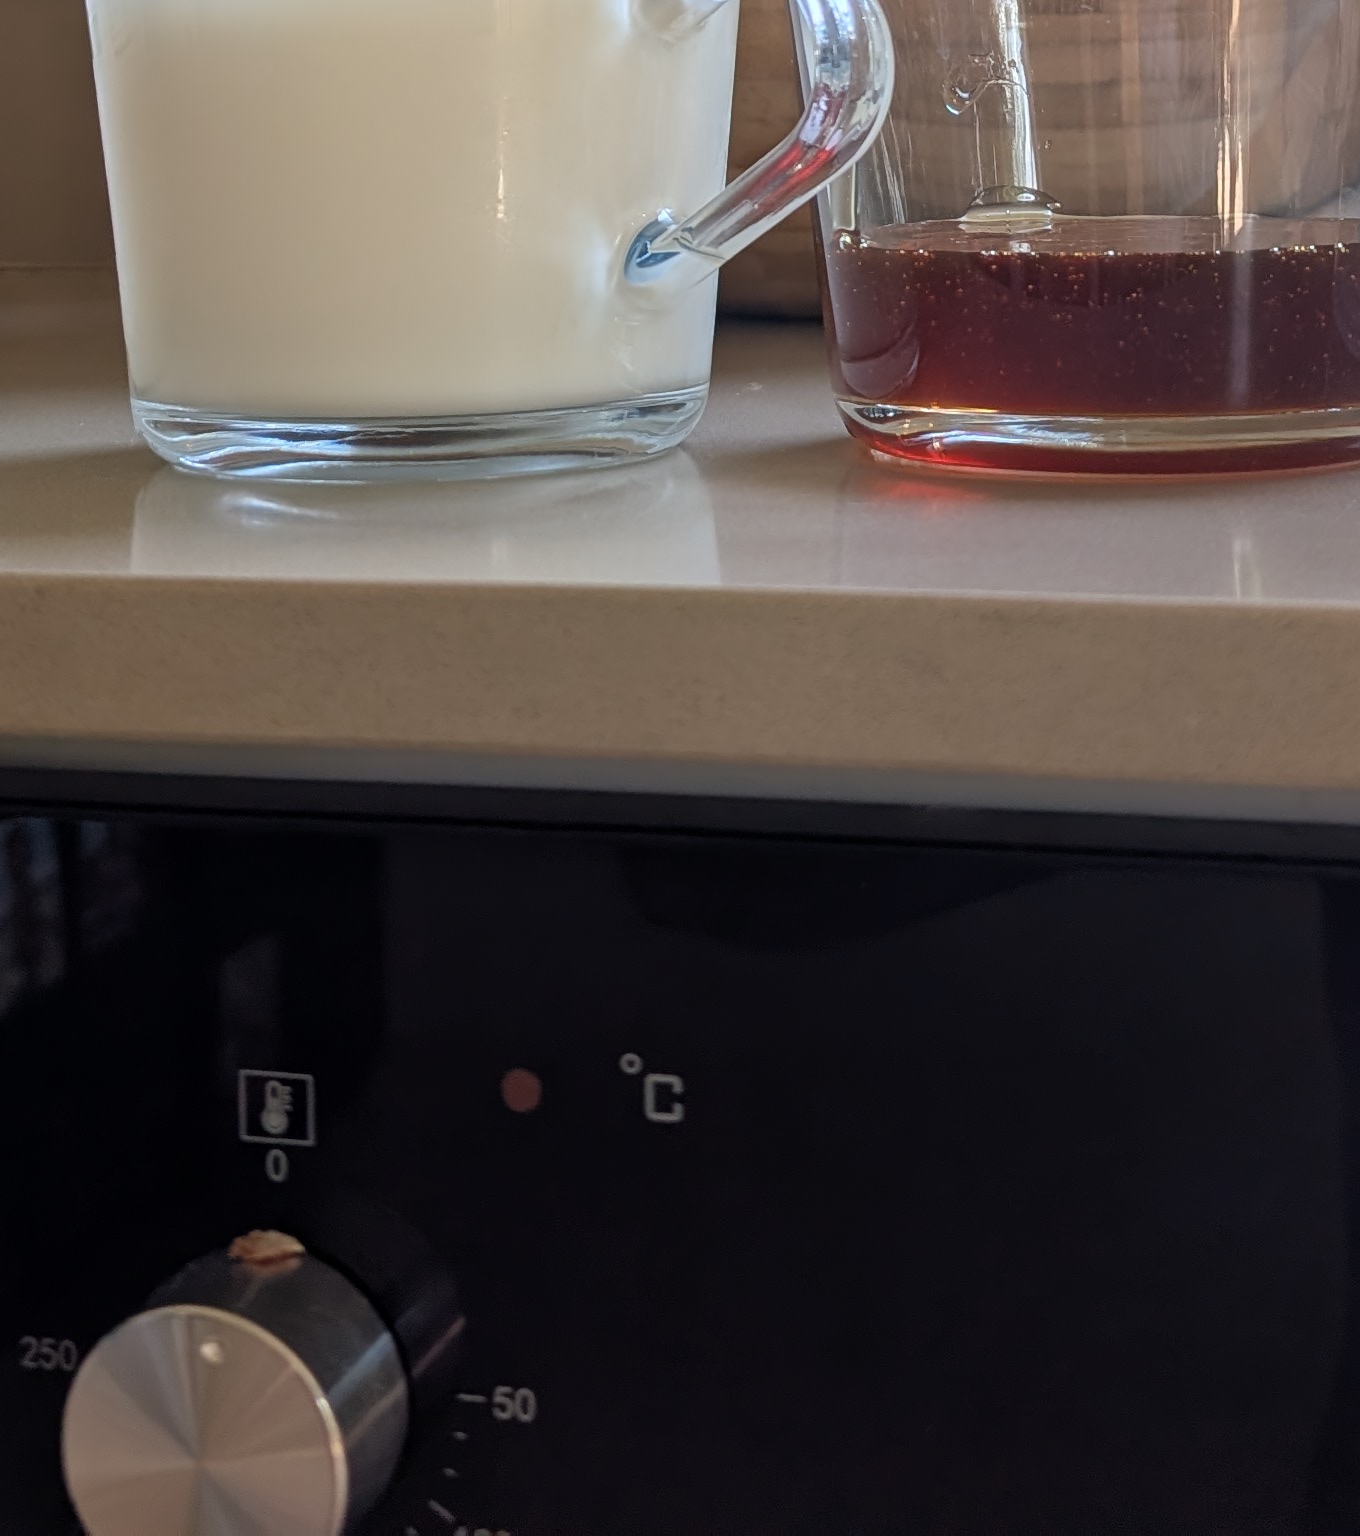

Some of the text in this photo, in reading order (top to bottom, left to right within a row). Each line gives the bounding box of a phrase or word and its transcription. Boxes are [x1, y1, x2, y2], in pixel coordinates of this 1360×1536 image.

[619, 1052, 685, 1124] °C
[265, 1149, 290, 1183] 0
[18, 1335, 78, 1372] 250
[491, 1384, 538, 1424] 50
